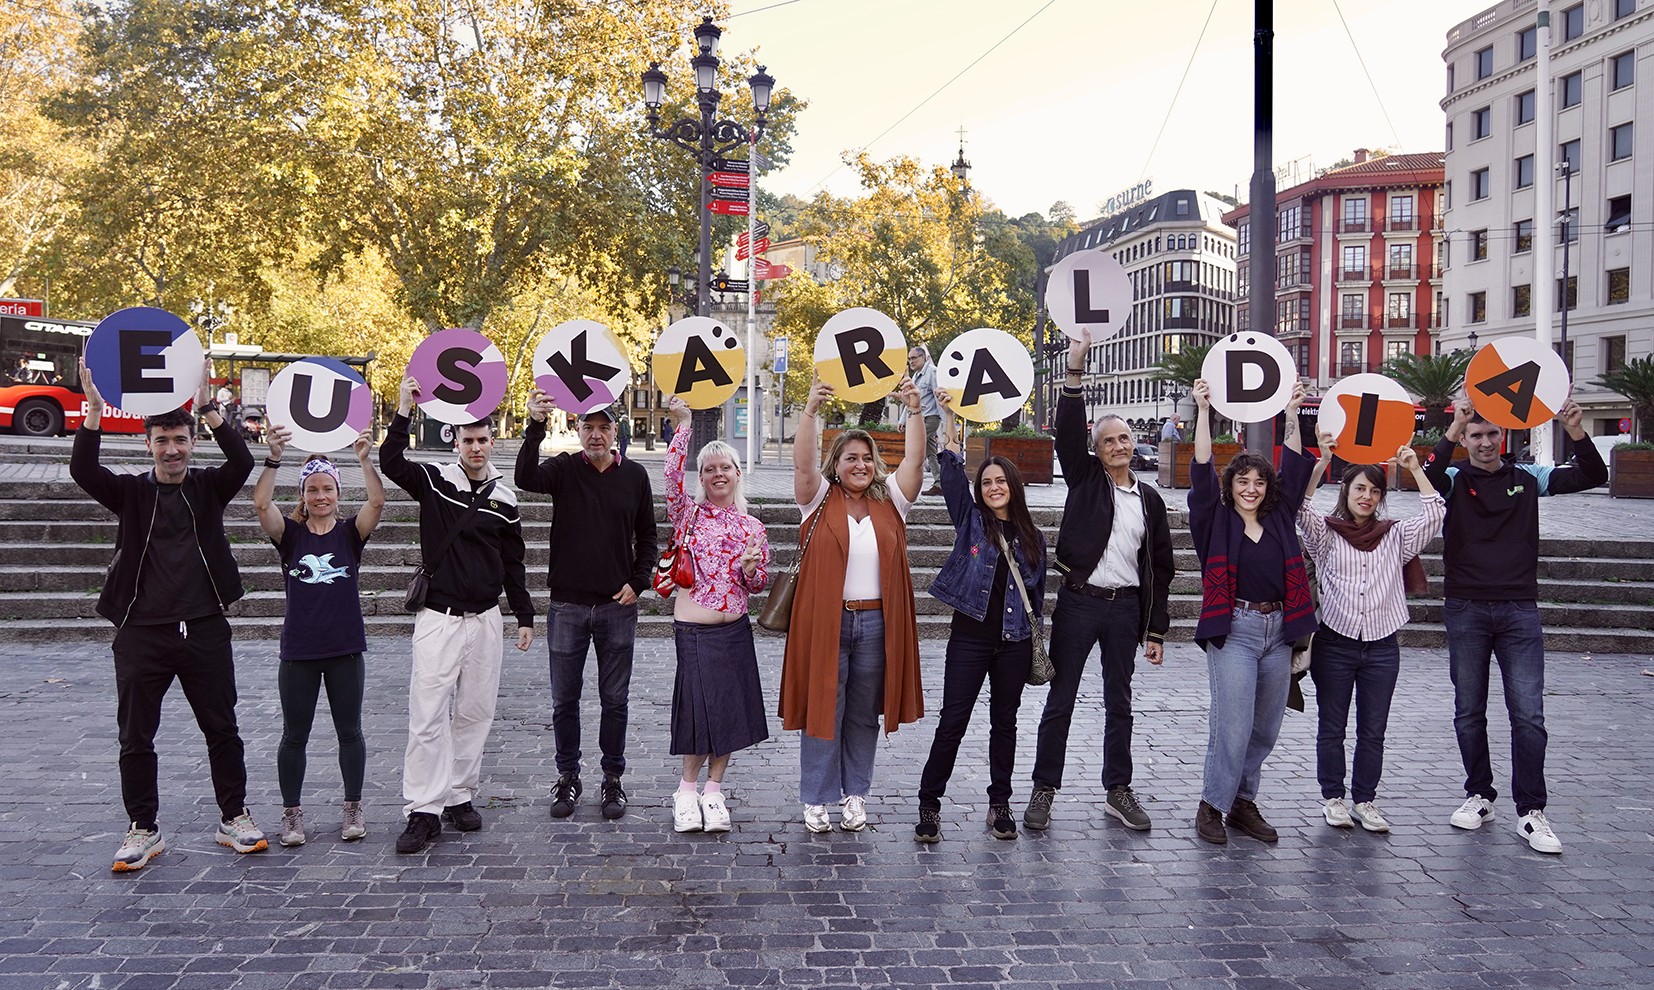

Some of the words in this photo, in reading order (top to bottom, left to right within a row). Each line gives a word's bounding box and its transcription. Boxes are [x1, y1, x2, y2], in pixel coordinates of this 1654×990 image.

[1115, 178, 1153, 209] surne
[0, 303, 27, 315] ería
[1073, 269, 1110, 324] L
[24, 321, 93, 336] CITARO
[834, 326, 895, 388] R
[119, 330, 174, 393] E
[432, 347, 483, 405] S
[545, 329, 621, 403] K
[674, 335, 733, 394] A
[960, 347, 1021, 407] A
[1225, 350, 1281, 403] D
[289, 373, 353, 433] U
[1301, 407, 1319, 416] elektr
[1354, 393, 1379, 447] I
[1474, 360, 1541, 423] A
